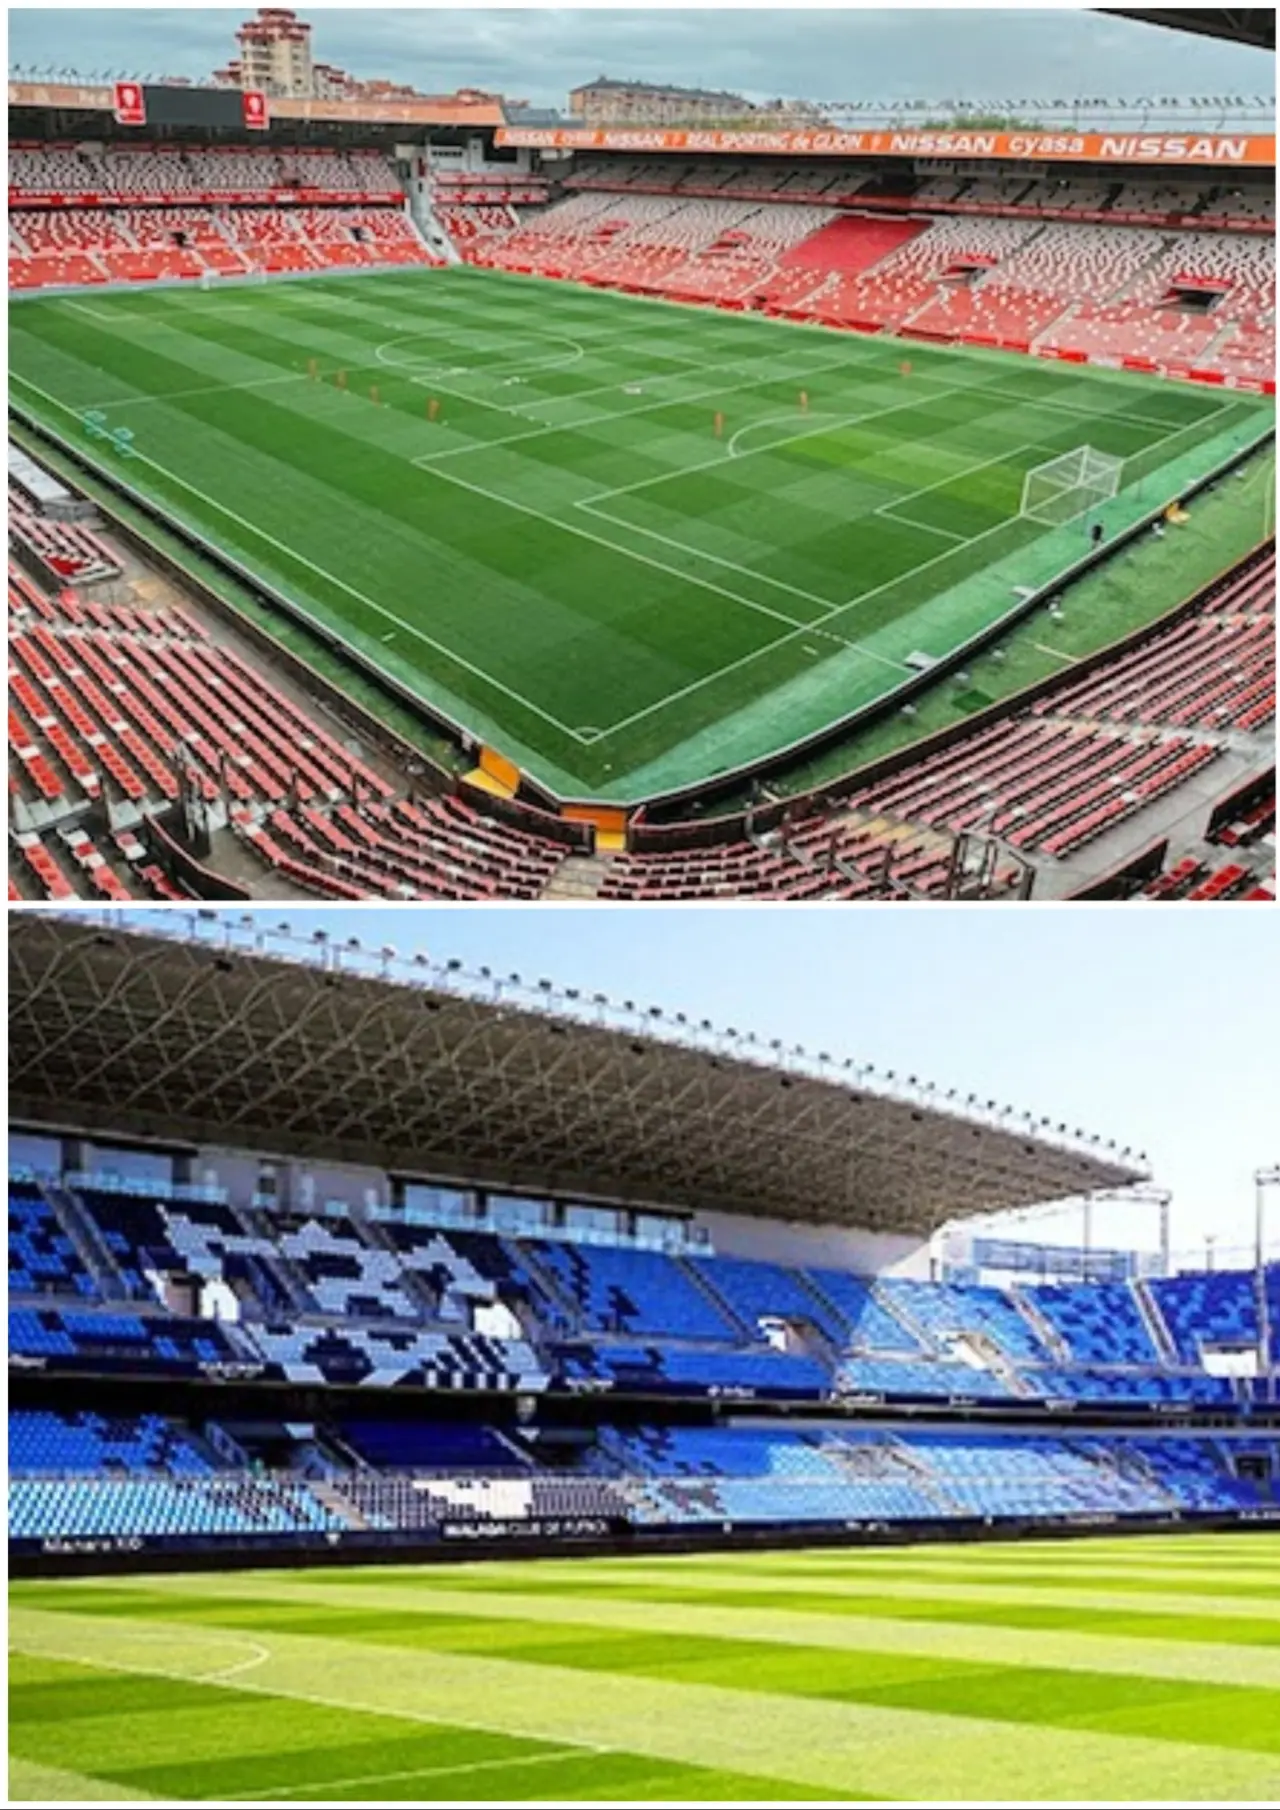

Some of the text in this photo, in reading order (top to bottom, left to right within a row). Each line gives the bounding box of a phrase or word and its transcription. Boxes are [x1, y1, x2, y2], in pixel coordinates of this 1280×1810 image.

[890, 135, 995, 154] NISSAN
[1009, 136, 1085, 155] cyasa
[1100, 136, 1248, 160] NISSAN
